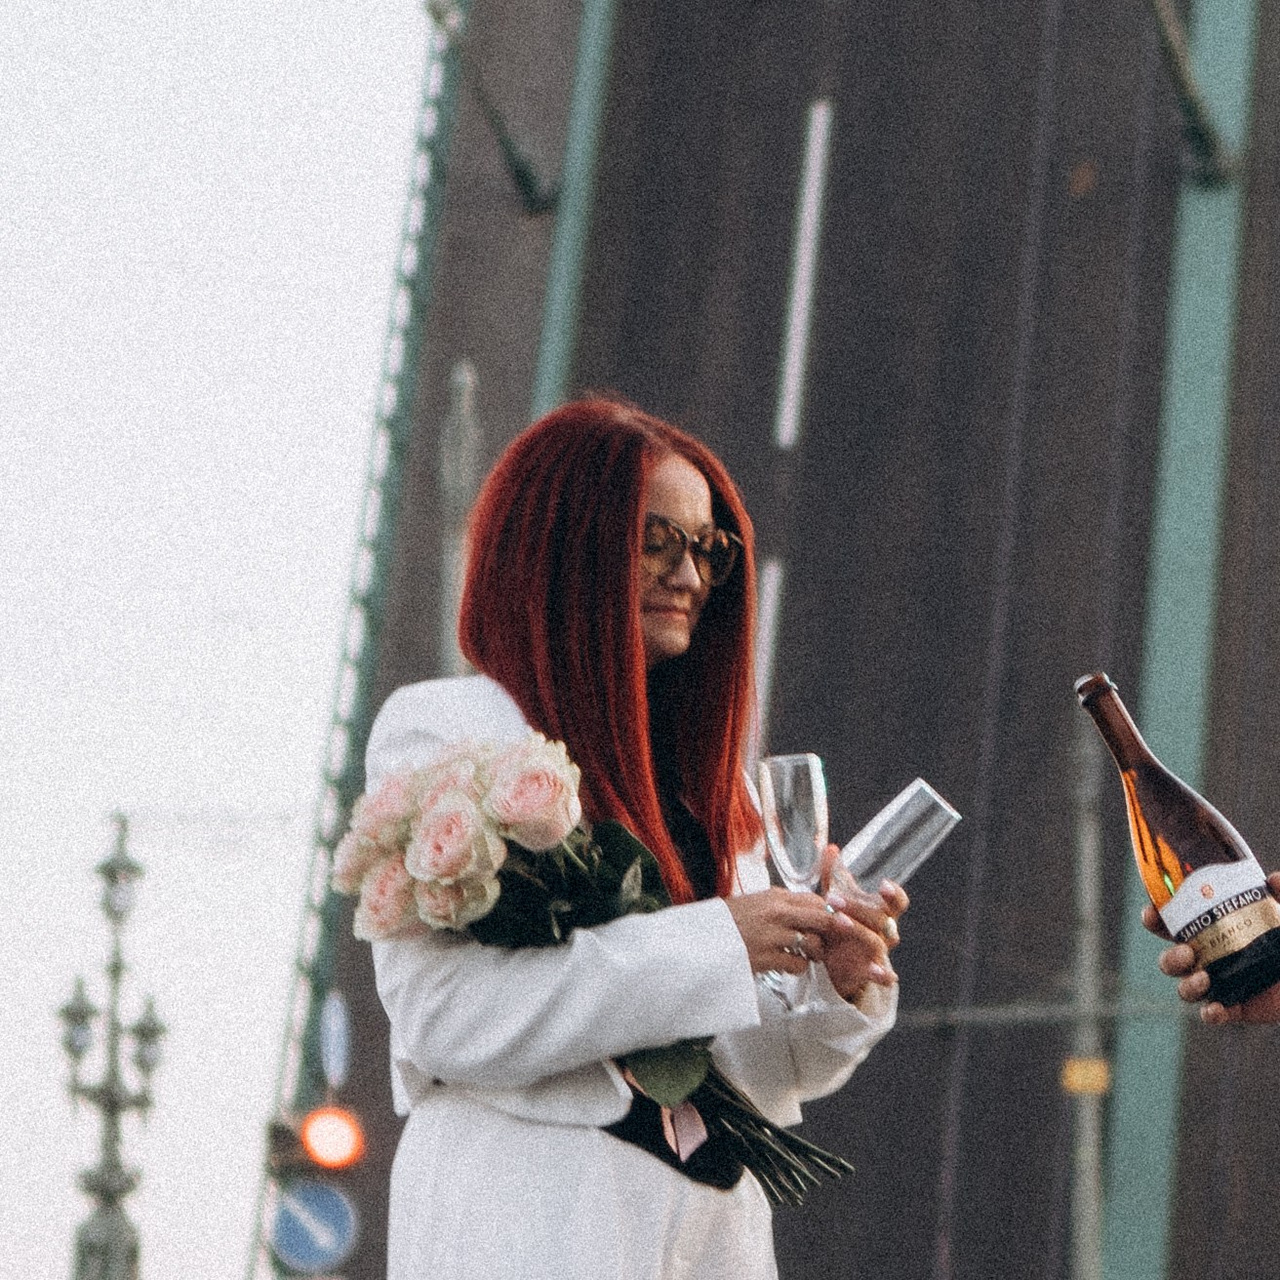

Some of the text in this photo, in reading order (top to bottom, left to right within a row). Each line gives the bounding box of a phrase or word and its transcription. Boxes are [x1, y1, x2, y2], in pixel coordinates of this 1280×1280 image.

[1180, 914, 1212, 942] SANTO
[1212, 888, 1261, 920] STEFANO
[1209, 918, 1252, 948] BIANCO
